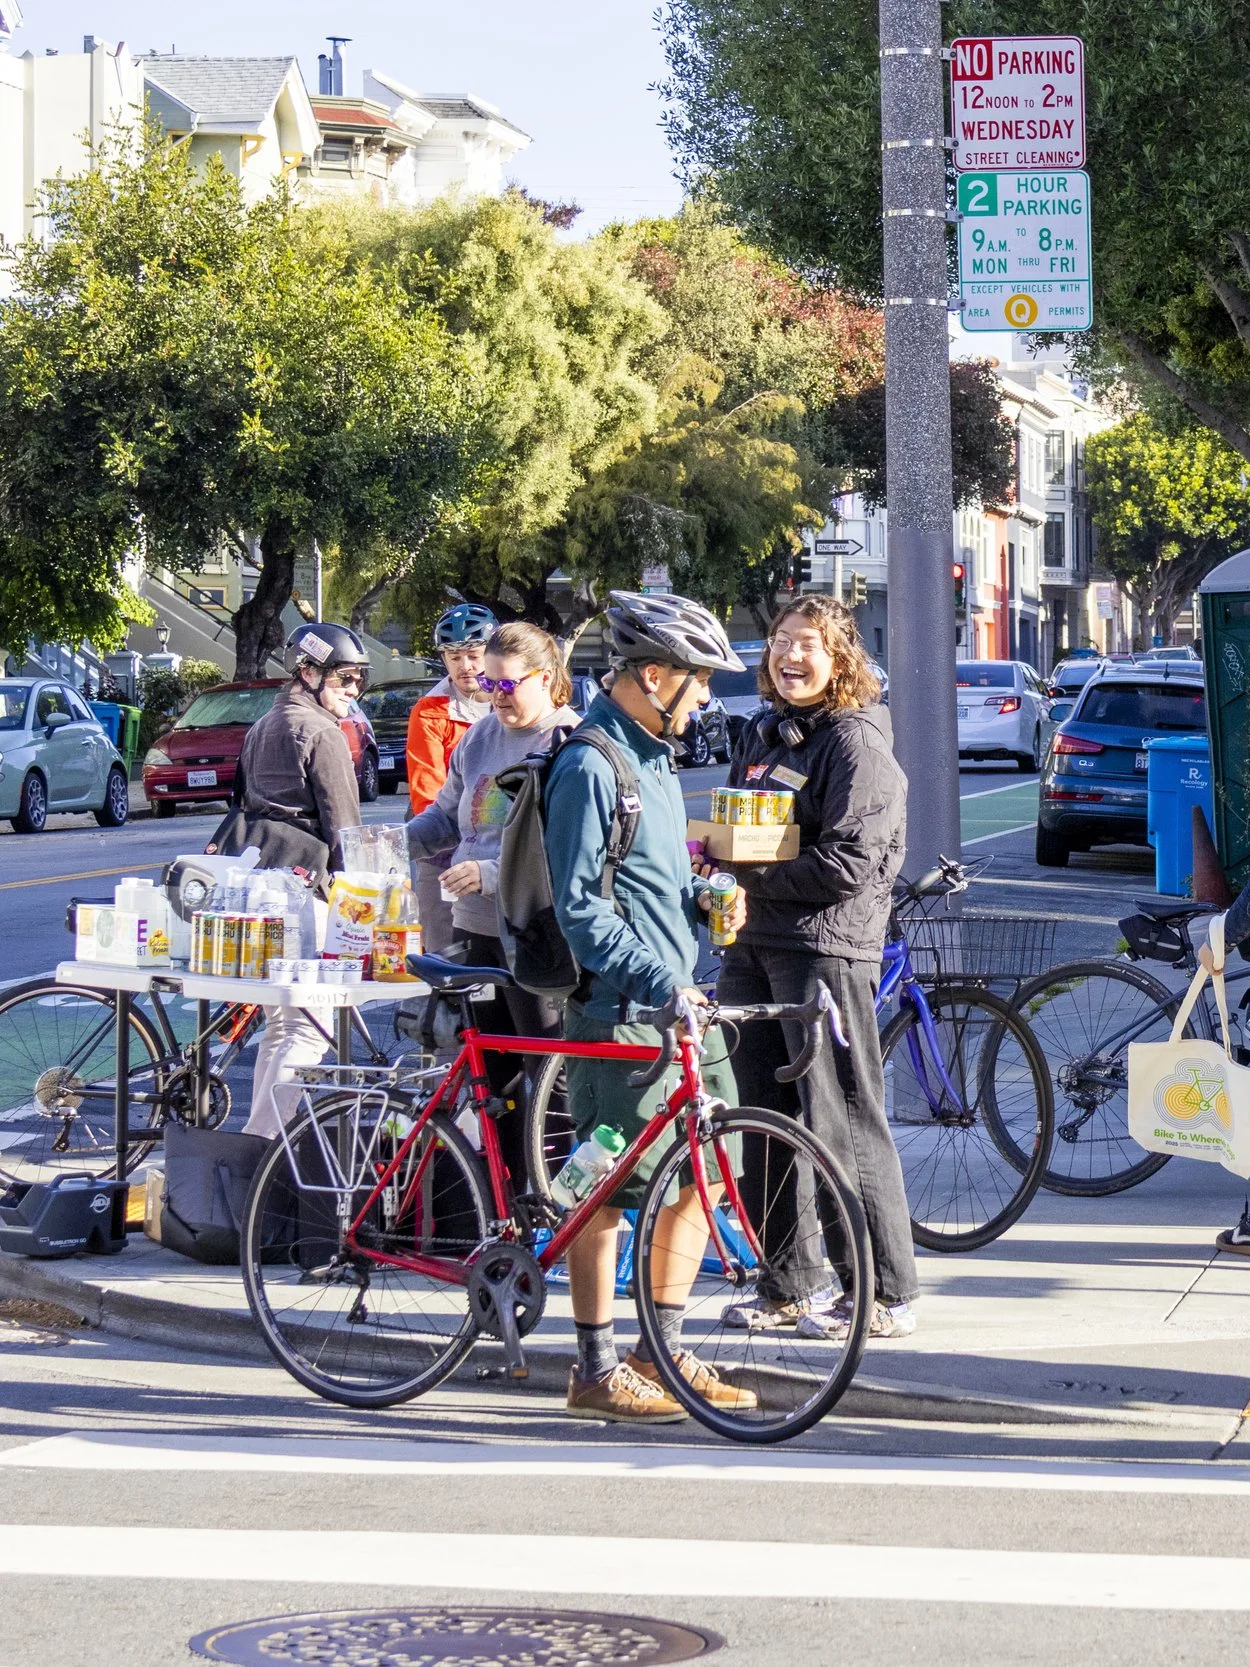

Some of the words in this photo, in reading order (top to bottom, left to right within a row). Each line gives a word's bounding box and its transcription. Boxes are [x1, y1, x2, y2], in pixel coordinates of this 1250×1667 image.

[956, 43, 988, 77] NO
[998, 50, 1075, 75] PARKING
[1024, 99, 1035, 108] TO
[961, 119, 1075, 140] WEDNESDAY
[965, 152, 1009, 165] STREET
[1016, 151, 1074, 164] CLEANING
[967, 179, 989, 212] 2
[1017, 177, 1068, 194] HOUR
[1003, 199, 1082, 216] PARKING
[1016, 228, 1027, 237] TO
[972, 258, 1008, 275] MON
[1017, 257, 1040, 267] THRU
[1050, 256, 1075, 273] FRI
[971, 284, 1004, 294] EXCEPT
[1011, 284, 1053, 294] VEHICLES
[1059, 283, 1081, 293] WITH
[968, 308, 990, 317] AREA
[1010, 299, 1031, 324] Q
[1048, 306, 1085, 316] PERMITS
[1180, 778, 1208, 787] Recology
[1153, 1128, 1175, 1139] Bike
[1176, 1131, 1187, 1140] To
